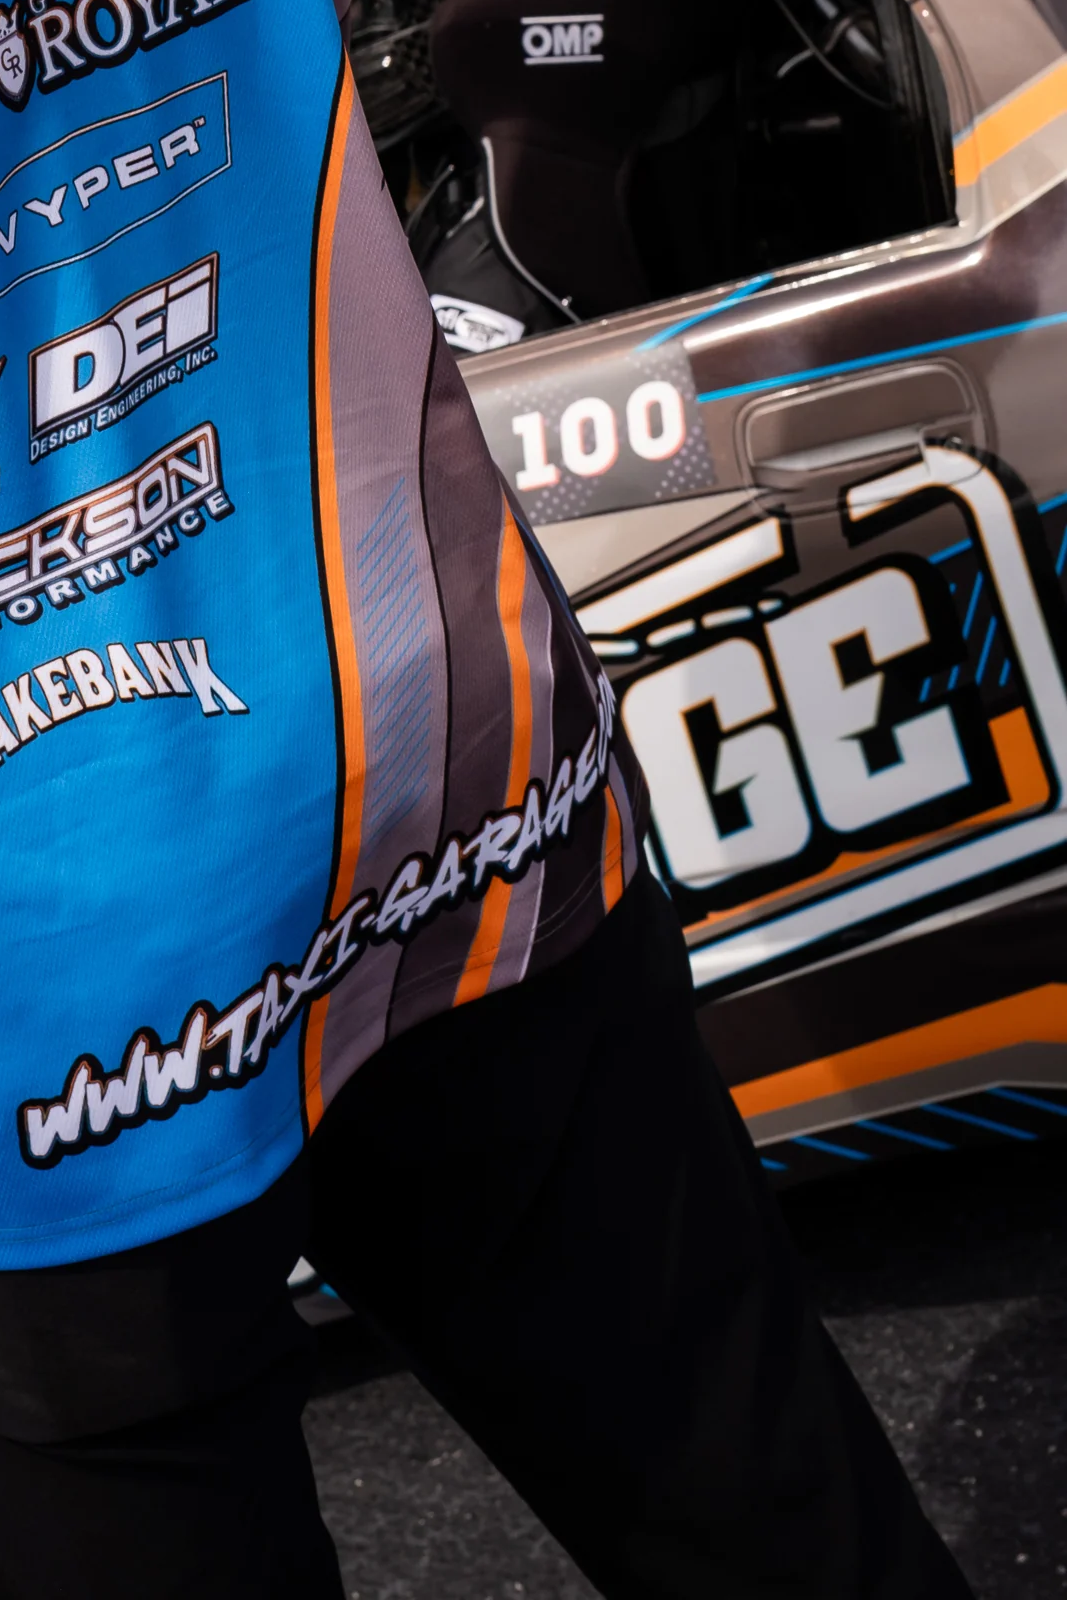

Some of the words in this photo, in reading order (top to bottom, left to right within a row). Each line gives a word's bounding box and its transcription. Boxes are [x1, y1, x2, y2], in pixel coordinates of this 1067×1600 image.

[522, 23, 604, 56] OMP
[29, 416, 89, 463] DESIGN
[184, 344, 217, 373] INC.
[510, 379, 687, 492] 100
